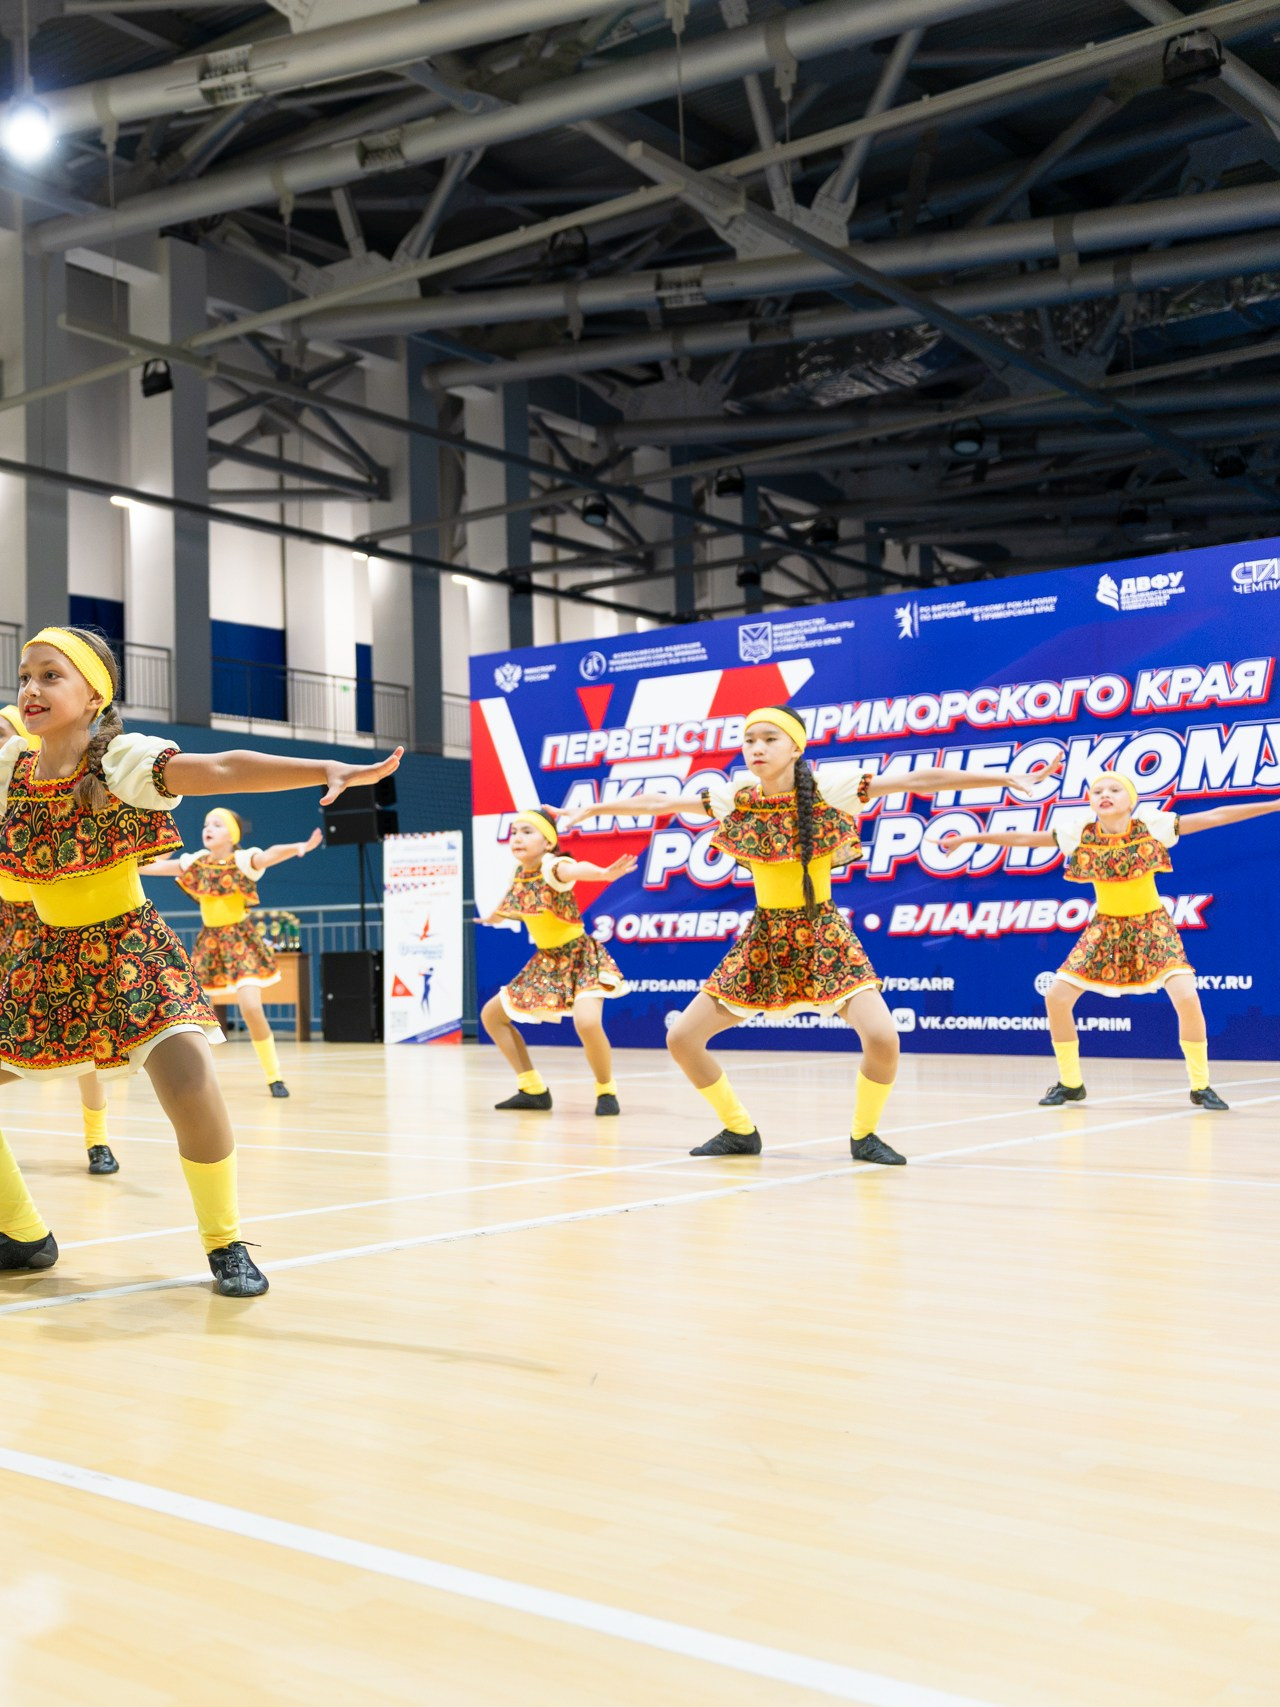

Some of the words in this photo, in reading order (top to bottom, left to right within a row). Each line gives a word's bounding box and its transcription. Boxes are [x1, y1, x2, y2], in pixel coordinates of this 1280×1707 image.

[1120, 570, 1184, 594] ДВФУ
[540, 713, 750, 770] ПЕРВЕНСТВ
[1132, 656, 1276, 715] КРАЯ
[888, 892, 1213, 938] ВЛАДИВОК
